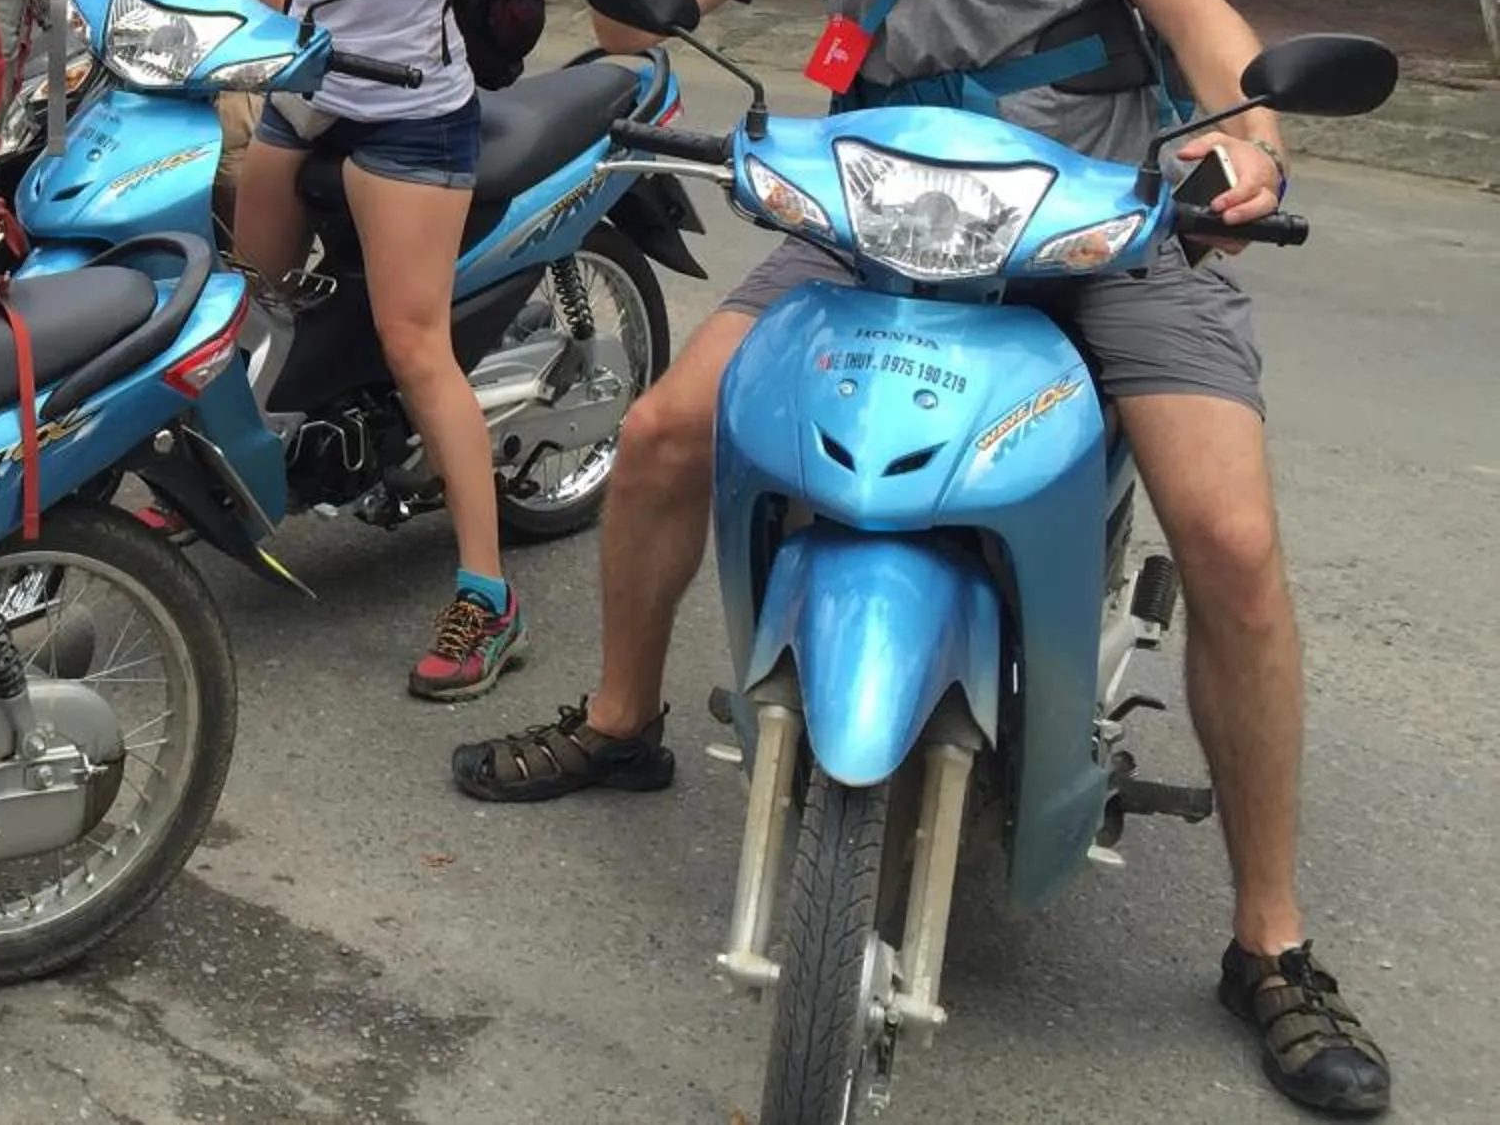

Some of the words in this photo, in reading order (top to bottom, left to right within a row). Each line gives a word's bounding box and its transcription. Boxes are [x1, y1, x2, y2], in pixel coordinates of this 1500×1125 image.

[854, 327, 940, 351] HONDA
[880, 354, 917, 377] 0975
[917, 362, 942, 385] 190
[942, 370, 968, 394] 219
